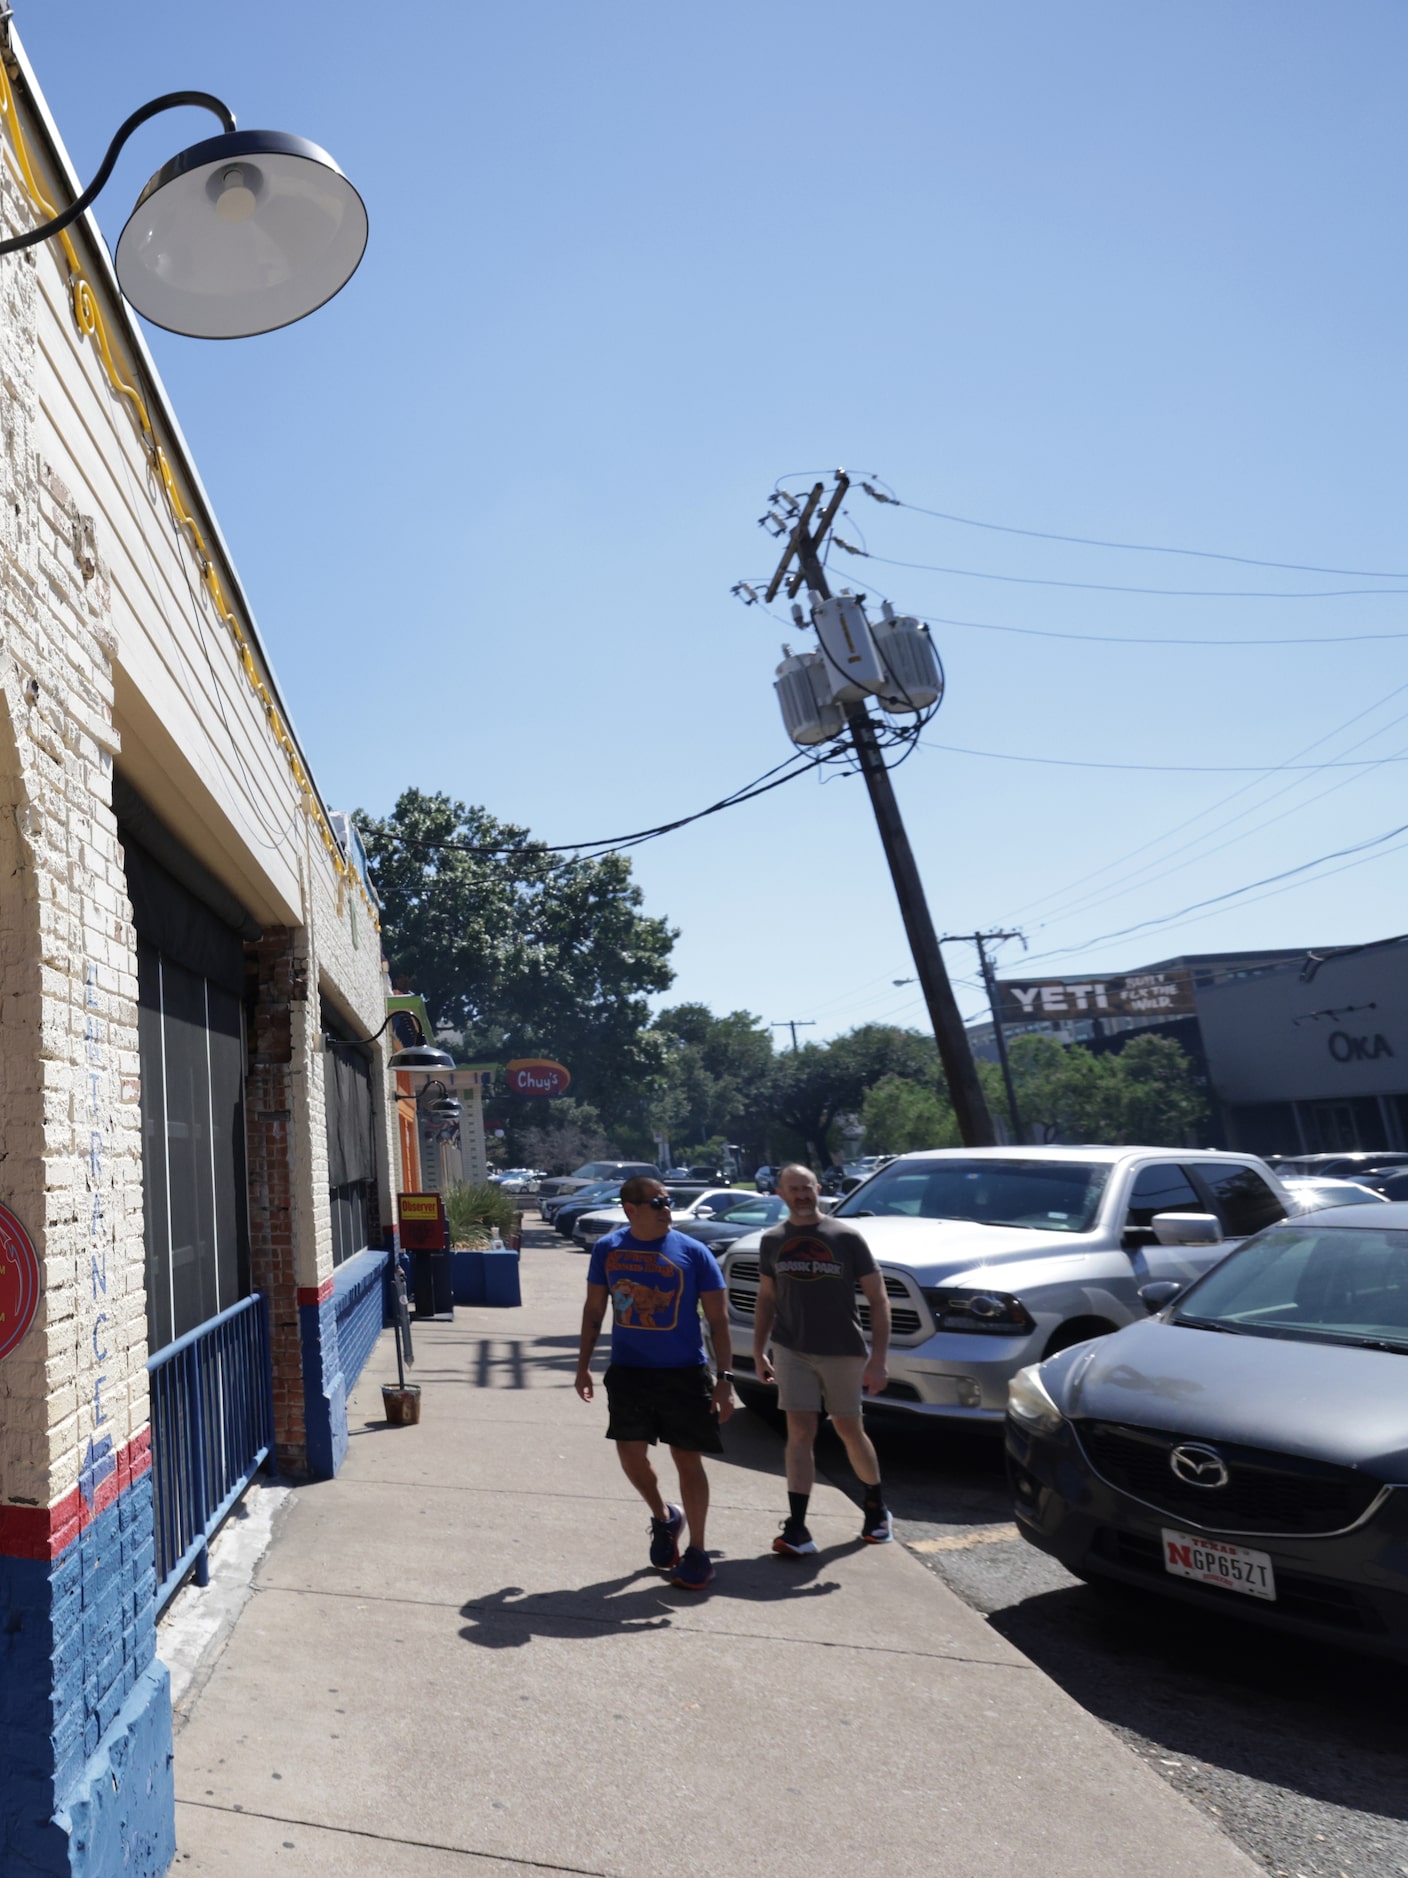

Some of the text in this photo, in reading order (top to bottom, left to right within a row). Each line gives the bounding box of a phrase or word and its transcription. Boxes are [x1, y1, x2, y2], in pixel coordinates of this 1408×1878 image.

[1010, 984, 1109, 1012] YETI
[1329, 1030, 1394, 1062] OKA
[517, 1071, 558, 1091] Chuy's
[85, 961, 109, 1426] ENTRANCE
[402, 1200, 435, 1212] Observer
[1192, 1538, 1237, 1556] TEXAS
